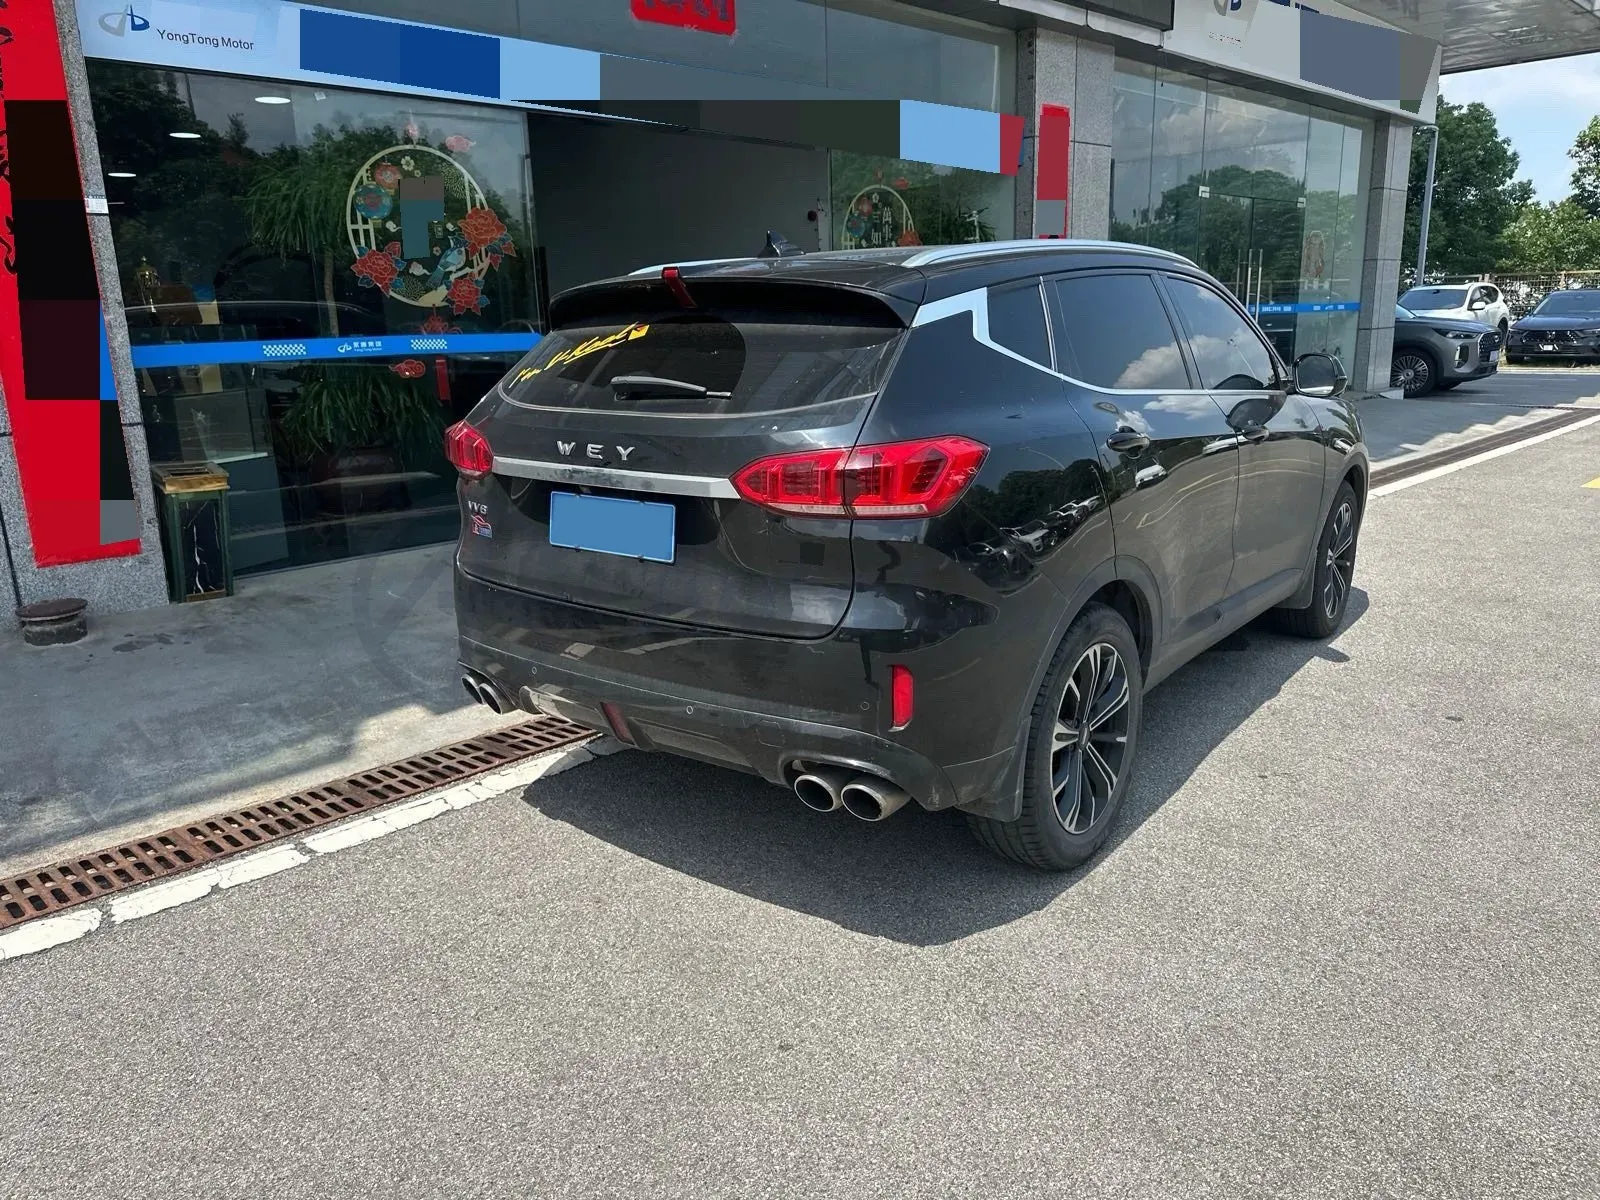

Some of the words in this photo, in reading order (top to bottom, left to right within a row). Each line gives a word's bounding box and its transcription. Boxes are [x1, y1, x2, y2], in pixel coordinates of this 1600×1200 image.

[156, 28, 219, 48] YongTong
[221, 37, 255, 50] Motor
[556, 440, 636, 461] WEY
[468, 500, 488, 515] VV6
